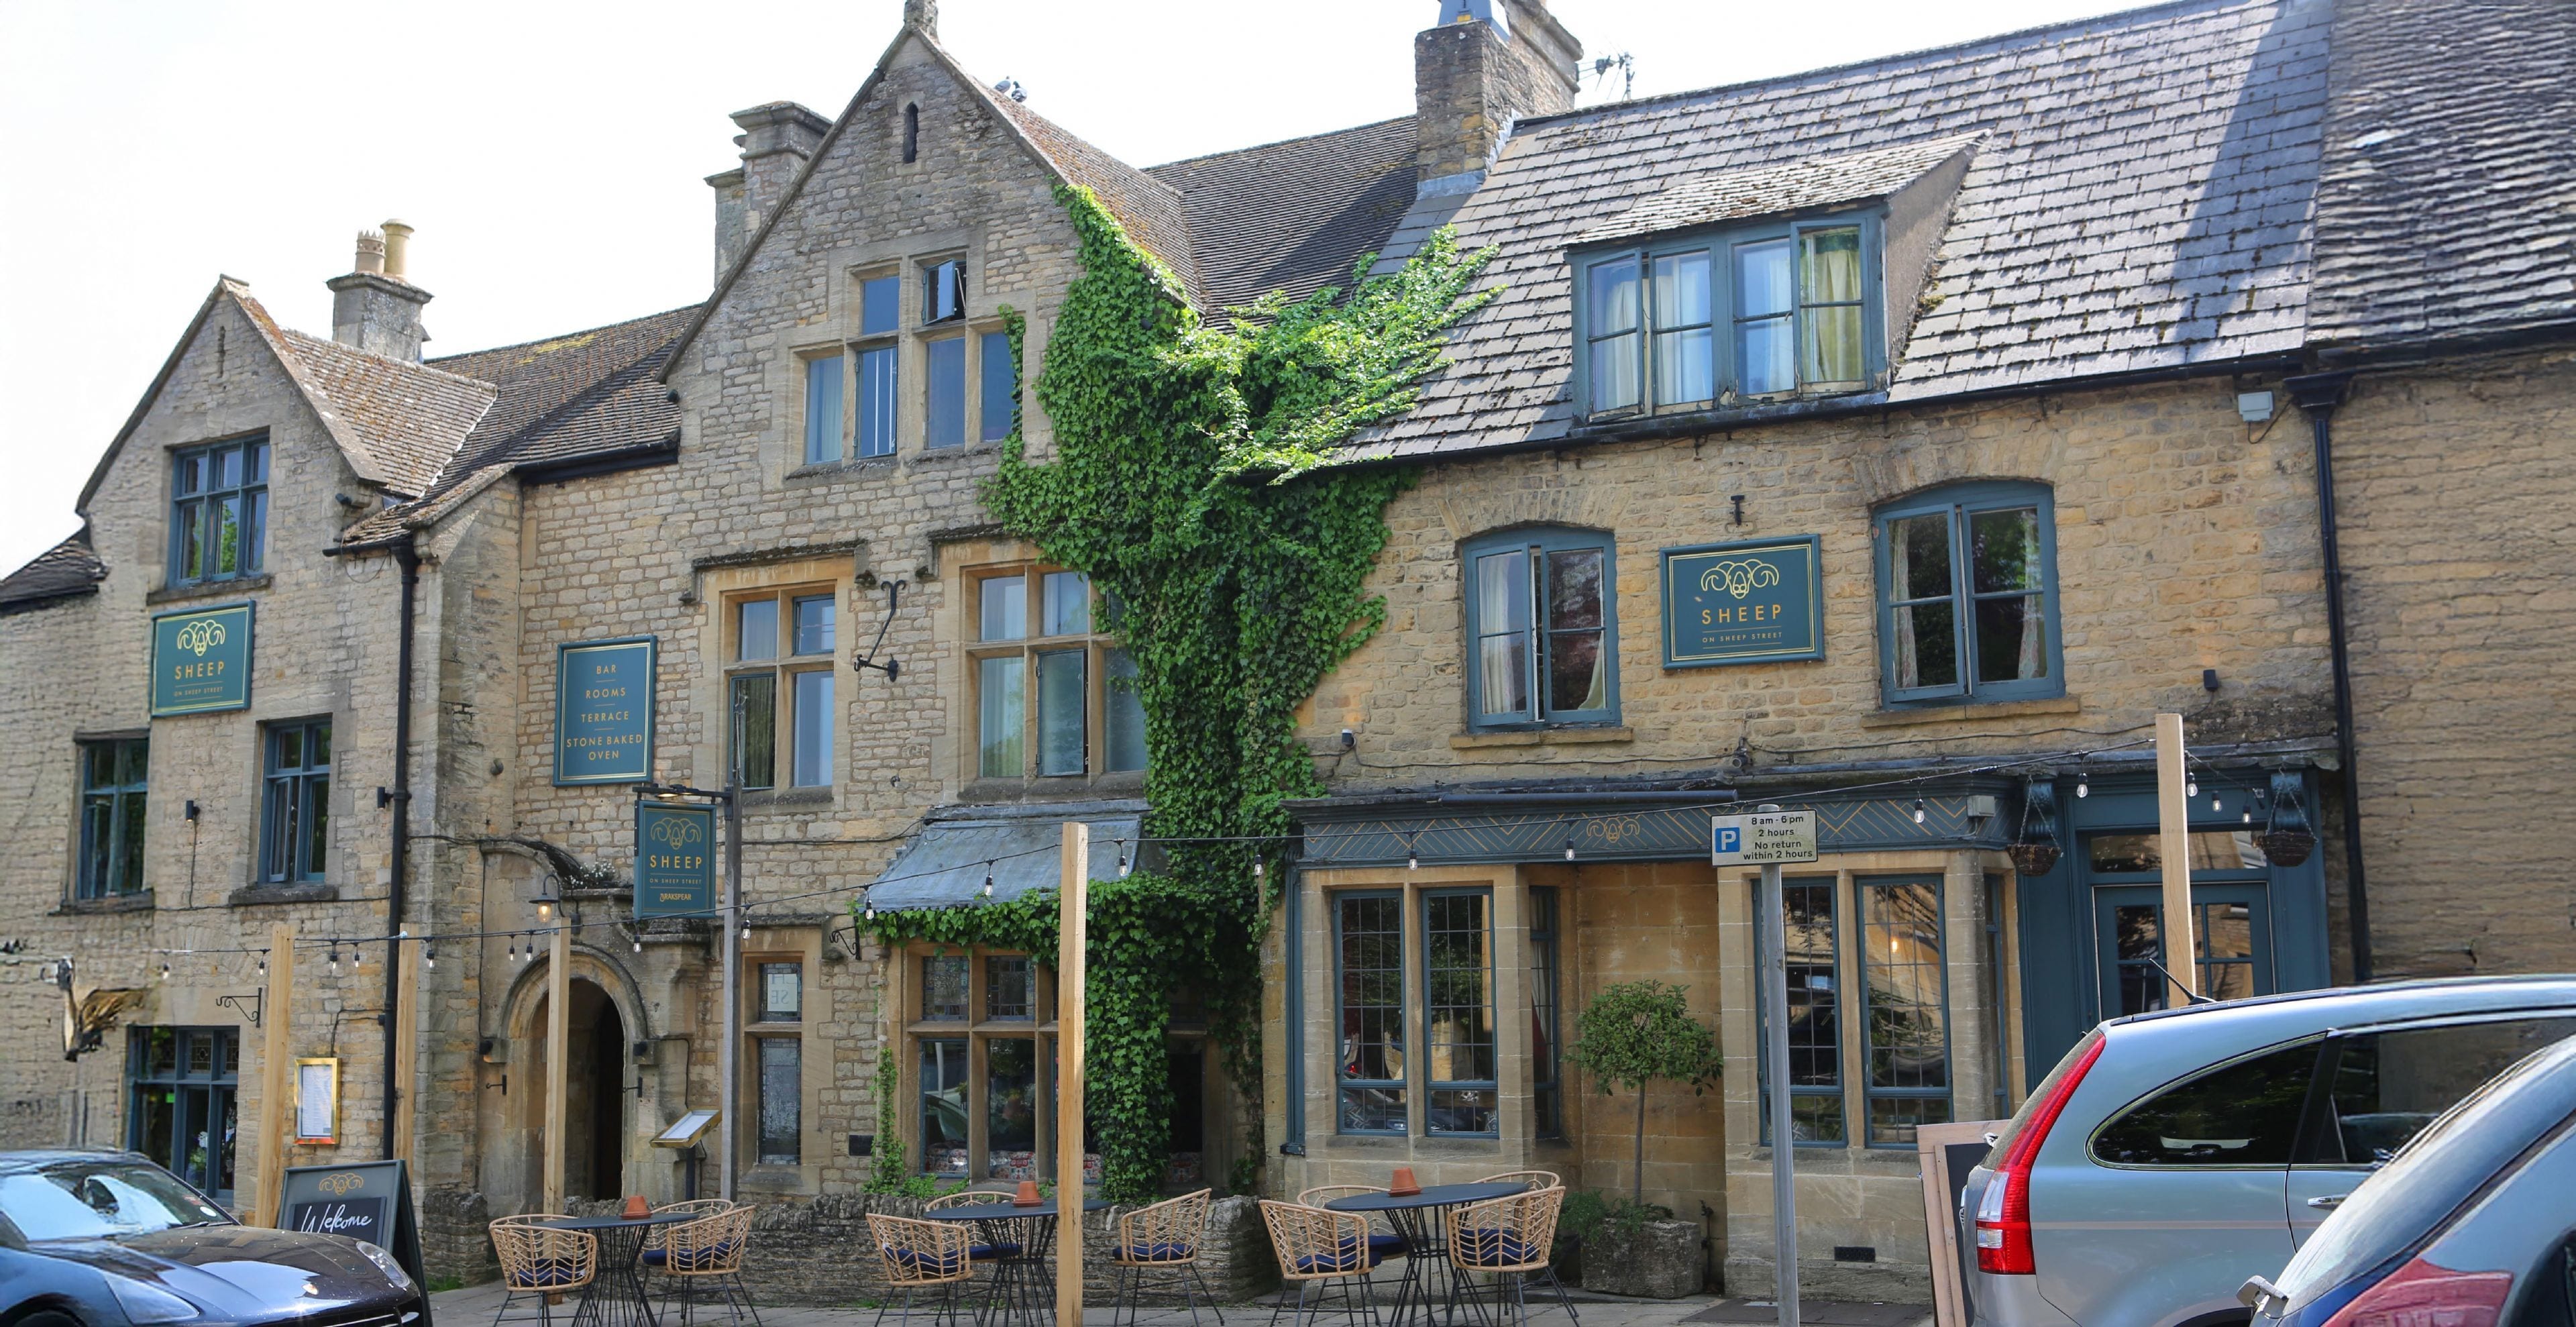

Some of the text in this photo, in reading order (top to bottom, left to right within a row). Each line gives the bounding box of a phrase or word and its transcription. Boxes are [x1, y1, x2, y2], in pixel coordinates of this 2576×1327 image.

[1701, 604, 1782, 625] SHEEP
[174, 660, 224, 680] SHEEP
[596, 665, 616, 674] BAR
[586, 687, 626, 699] ROOMS
[581, 711, 629, 723] TERRACE
[566, 735, 642, 747] STONE BAKED
[588, 751, 619, 760] OVEN
[1752, 817, 1757, 825] 8
[1789, 816, 1803, 825] pm
[1768, 829, 1794, 837] hours
[1721, 831, 1737, 851] P
[1772, 841, 1801, 849] return
[1786, 849, 1813, 858] hours
[650, 855, 702, 869] SHEEP
[659, 893, 692, 902] BRAKSPEAR
[301, 1204, 372, 1234] Welcome
